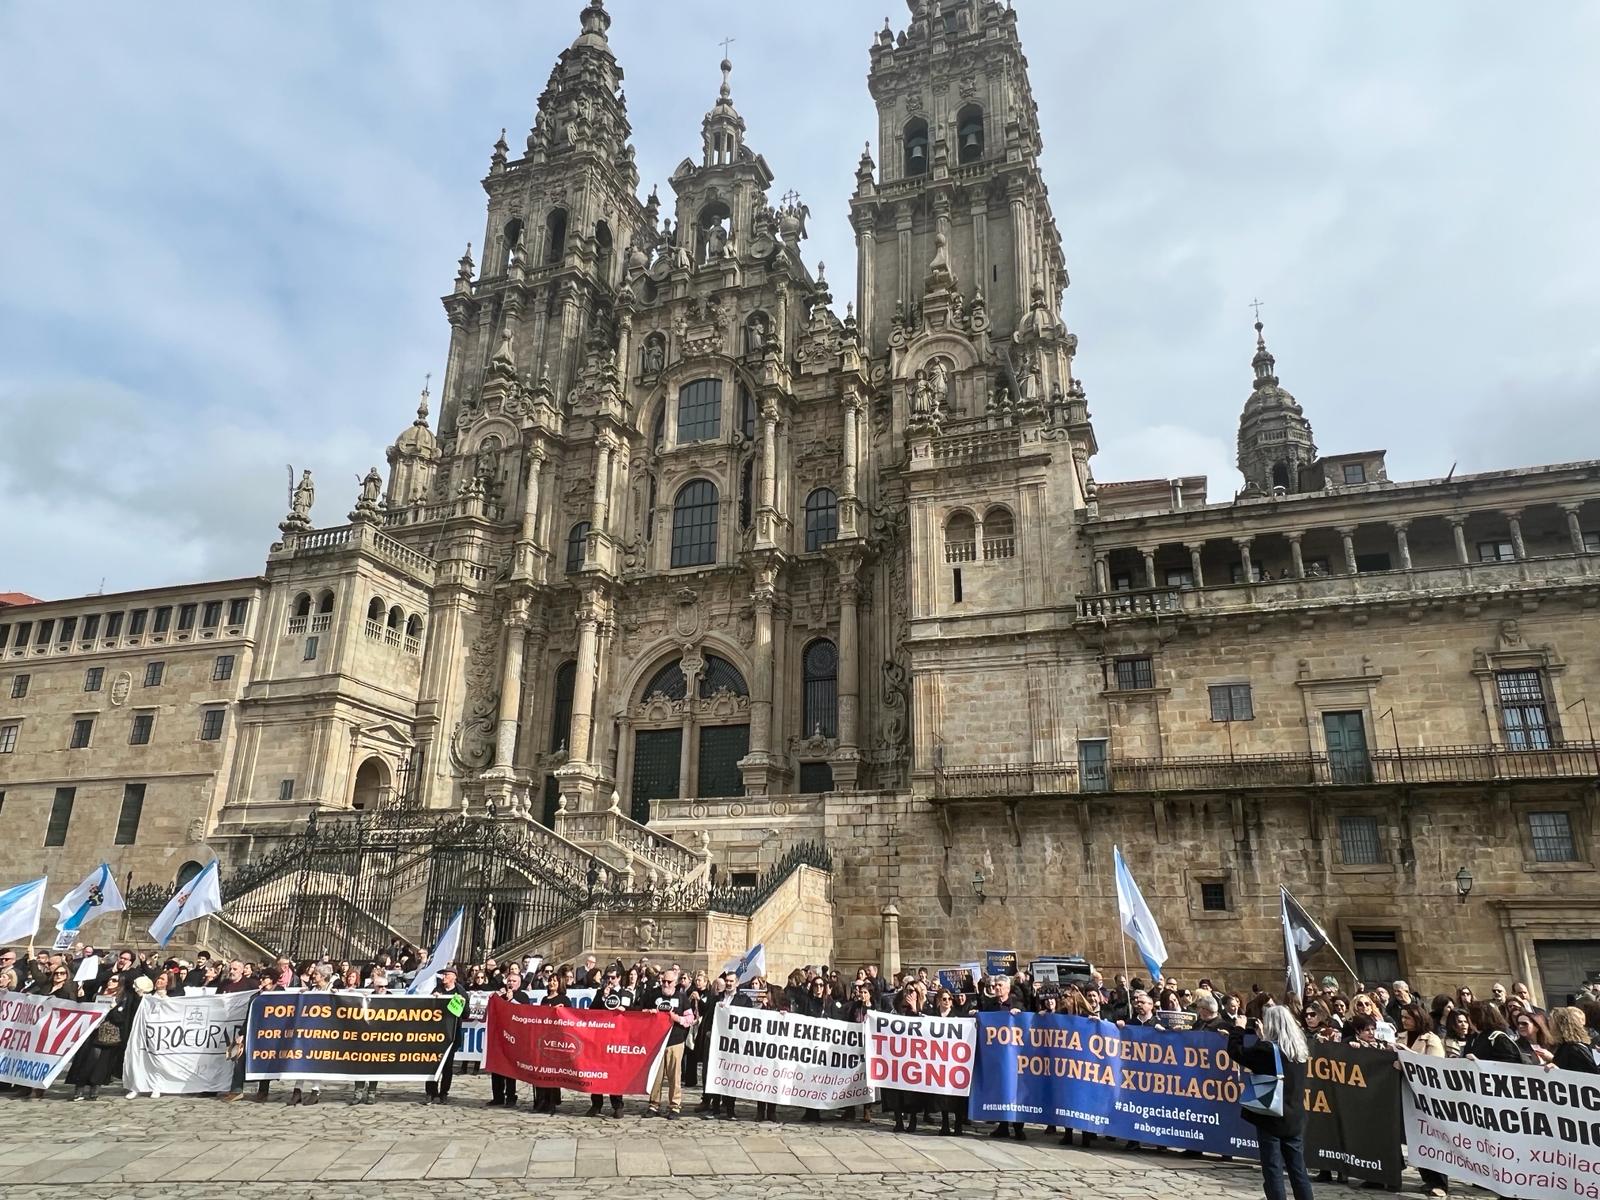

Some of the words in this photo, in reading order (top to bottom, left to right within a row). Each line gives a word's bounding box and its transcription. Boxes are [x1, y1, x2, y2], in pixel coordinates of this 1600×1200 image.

[263, 1005, 296, 1018] POR
[301, 1005, 332, 1018] LOS
[336, 1007, 442, 1021] CIUDADANOS
[554, 1018, 575, 1027] oficio
[576, 1020, 587, 1028] de
[588, 1020, 616, 1029] Murcia
[258, 1029, 282, 1039] POR
[297, 1029, 340, 1040] TURNO
[342, 1031, 358, 1040] DE
[361, 1032, 402, 1042] OFICIO
[406, 1032, 445, 1042] DIGNO
[728, 1014, 762, 1034] POR
[766, 1019, 790, 1037] UN
[793, 1023, 865, 1048] EXERCICI
[876, 1017, 923, 1037] POR
[930, 1022, 963, 1040] UN
[252, 1050, 276, 1060] POR
[306, 1050, 396, 1062] JUBILACIONES
[543, 1039, 576, 1050] VENIA
[606, 1045, 647, 1055] HUELGA
[718, 1036, 740, 1054] DA
[743, 1040, 827, 1066] AVOGACÍA
[871, 1034, 972, 1064] TURNO
[986, 1026, 1024, 1046] POR
[1029, 1028, 1083, 1051] UNHA
[1088, 1034, 1178, 1066] QUENDA
[1184, 1046, 1210, 1070] DE
[15, 1060, 51, 1081] PROCUR
[578, 1071, 608, 1080] DIGNOS
[718, 1058, 750, 1074] Turno
[754, 1064, 768, 1076] de
[870, 1057, 971, 1090] DIGNO
[1017, 1055, 1051, 1076] POR
[1054, 1058, 1116, 1087] UNHA
[1306, 1056, 1367, 1088] IGNA
[1404, 1061, 1442, 1090] POR
[1442, 1068, 1476, 1094] UN
[714, 1076, 778, 1095] condicións
[782, 1085, 828, 1101] laborais
[1055, 1107, 1110, 1125] #mareanegra
[1114, 1101, 1220, 1126] #abogaciadeferrol
[1430, 1098, 1554, 1138] AVOGACÍA
[1134, 1122, 1204, 1140] #abogaciaunida
[1452, 1132, 1472, 1150] de
[1418, 1144, 1490, 1178] condicións
[1491, 1163, 1568, 1190] laborais
